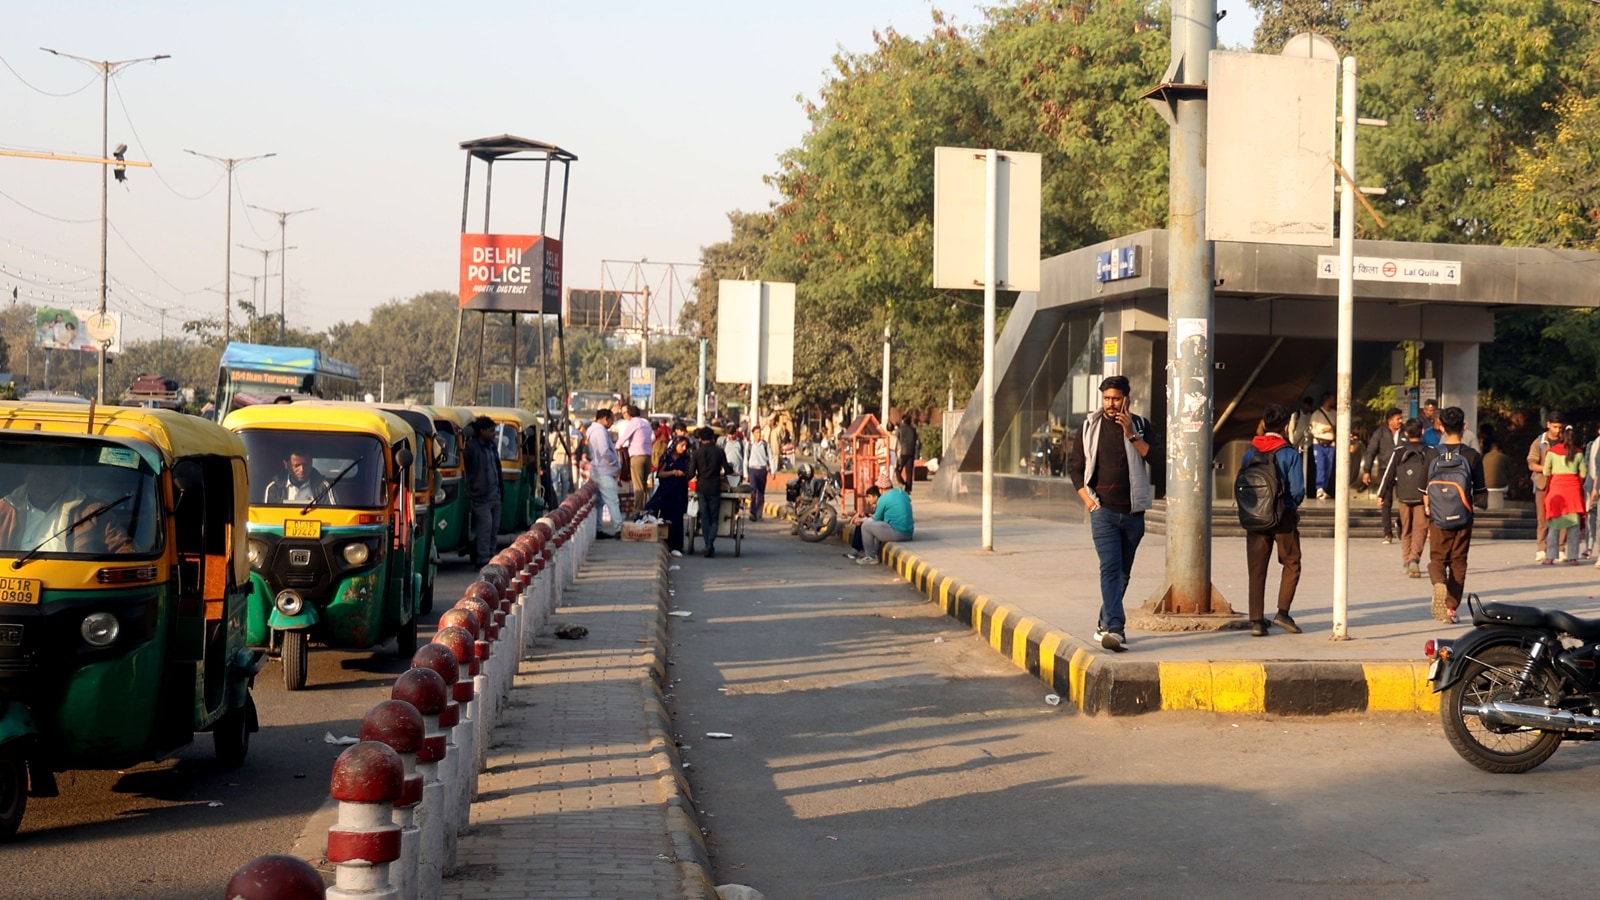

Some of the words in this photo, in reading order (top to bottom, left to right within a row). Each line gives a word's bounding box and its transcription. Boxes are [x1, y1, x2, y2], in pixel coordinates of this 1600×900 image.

[473, 247, 522, 264] DELHI
[1324, 263, 1332, 273] 4
[1358, 263, 1379, 274] किला
[1404, 268, 1416, 276] Lal
[1418, 268, 1439, 278] Quila
[468, 265, 531, 283] POLICE
[1447, 269, 1455, 279] 4
[472, 285, 494, 293] NORTH
[496, 285, 528, 294] DISTRICT
[263, 373, 298, 385] Terminal
[1, 591, 33, 603] 0809
